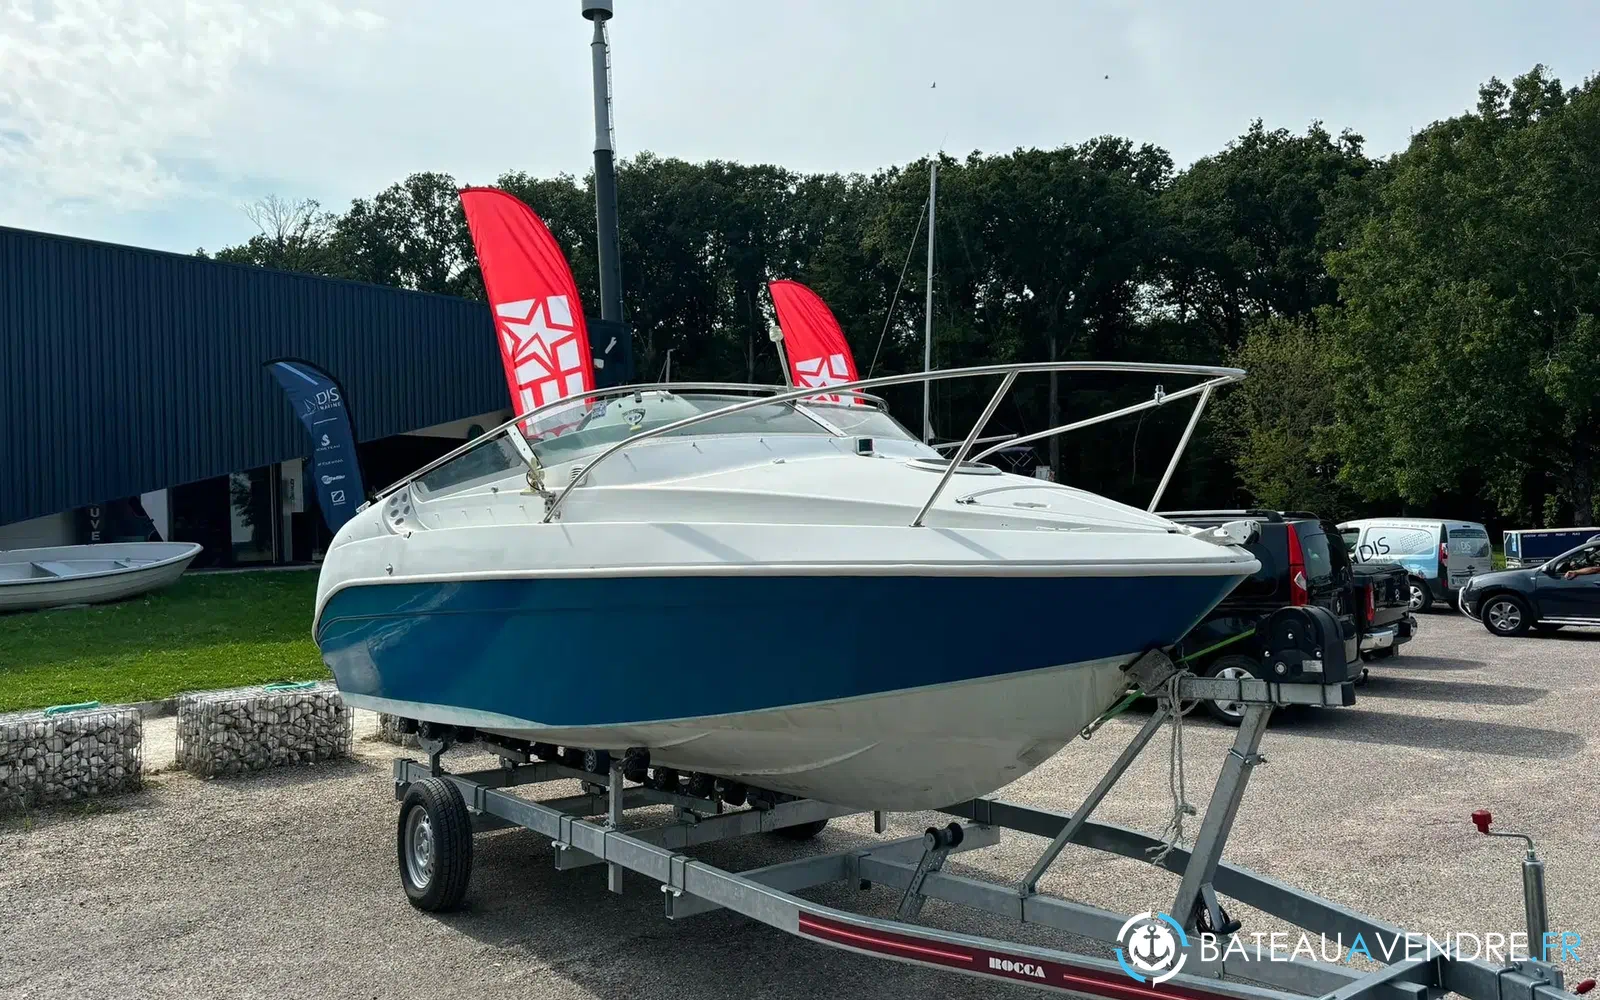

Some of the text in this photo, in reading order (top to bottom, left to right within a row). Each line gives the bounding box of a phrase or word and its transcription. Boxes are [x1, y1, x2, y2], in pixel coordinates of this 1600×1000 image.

[316, 387, 340, 404] DIS
[1358, 537, 1391, 562] DIS
[988, 957, 1046, 979] ROCCA
